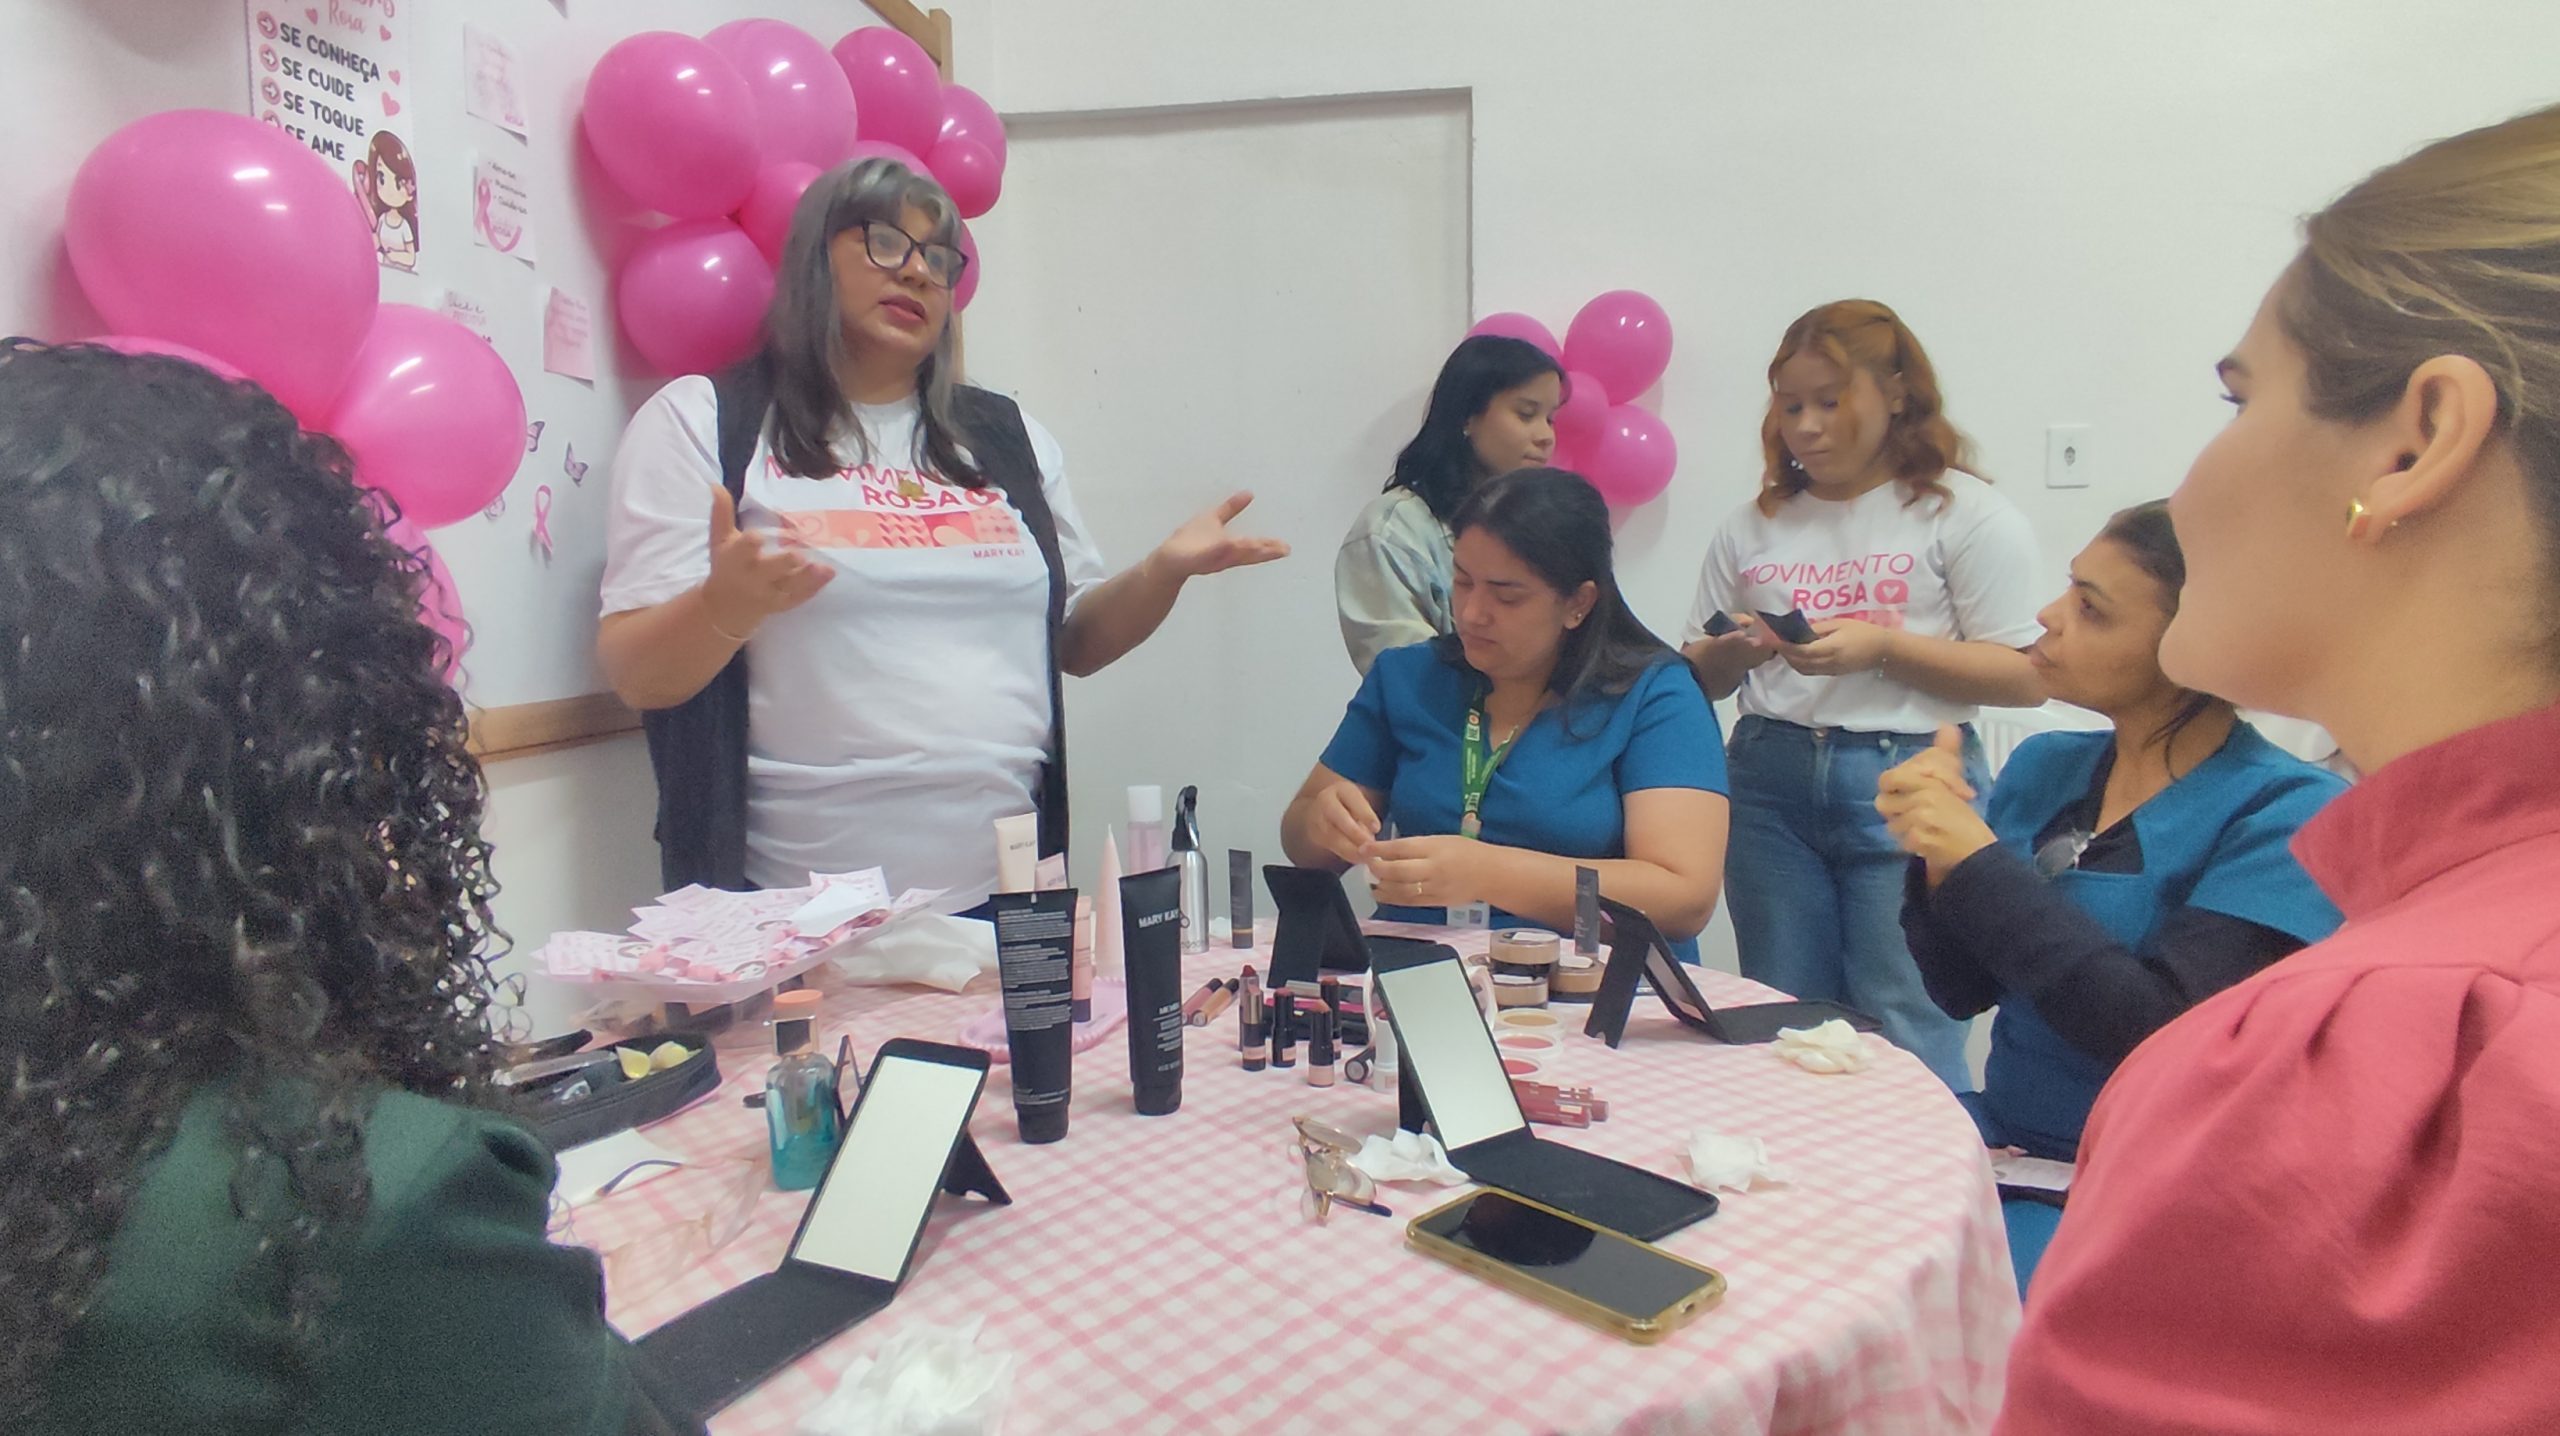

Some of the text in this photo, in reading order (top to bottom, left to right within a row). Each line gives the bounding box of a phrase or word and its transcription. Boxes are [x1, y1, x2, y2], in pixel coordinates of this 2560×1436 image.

[280, 22, 381, 83] SE CONHEÇA
[281, 56, 355, 102] SE CUIDE
[283, 90, 365, 137] SE TOQUE
[311, 134, 345, 161] AME
[862, 484, 962, 510] ROSA
[1792, 580, 1868, 611] ROSA
[1138, 912, 1163, 928] MARY
